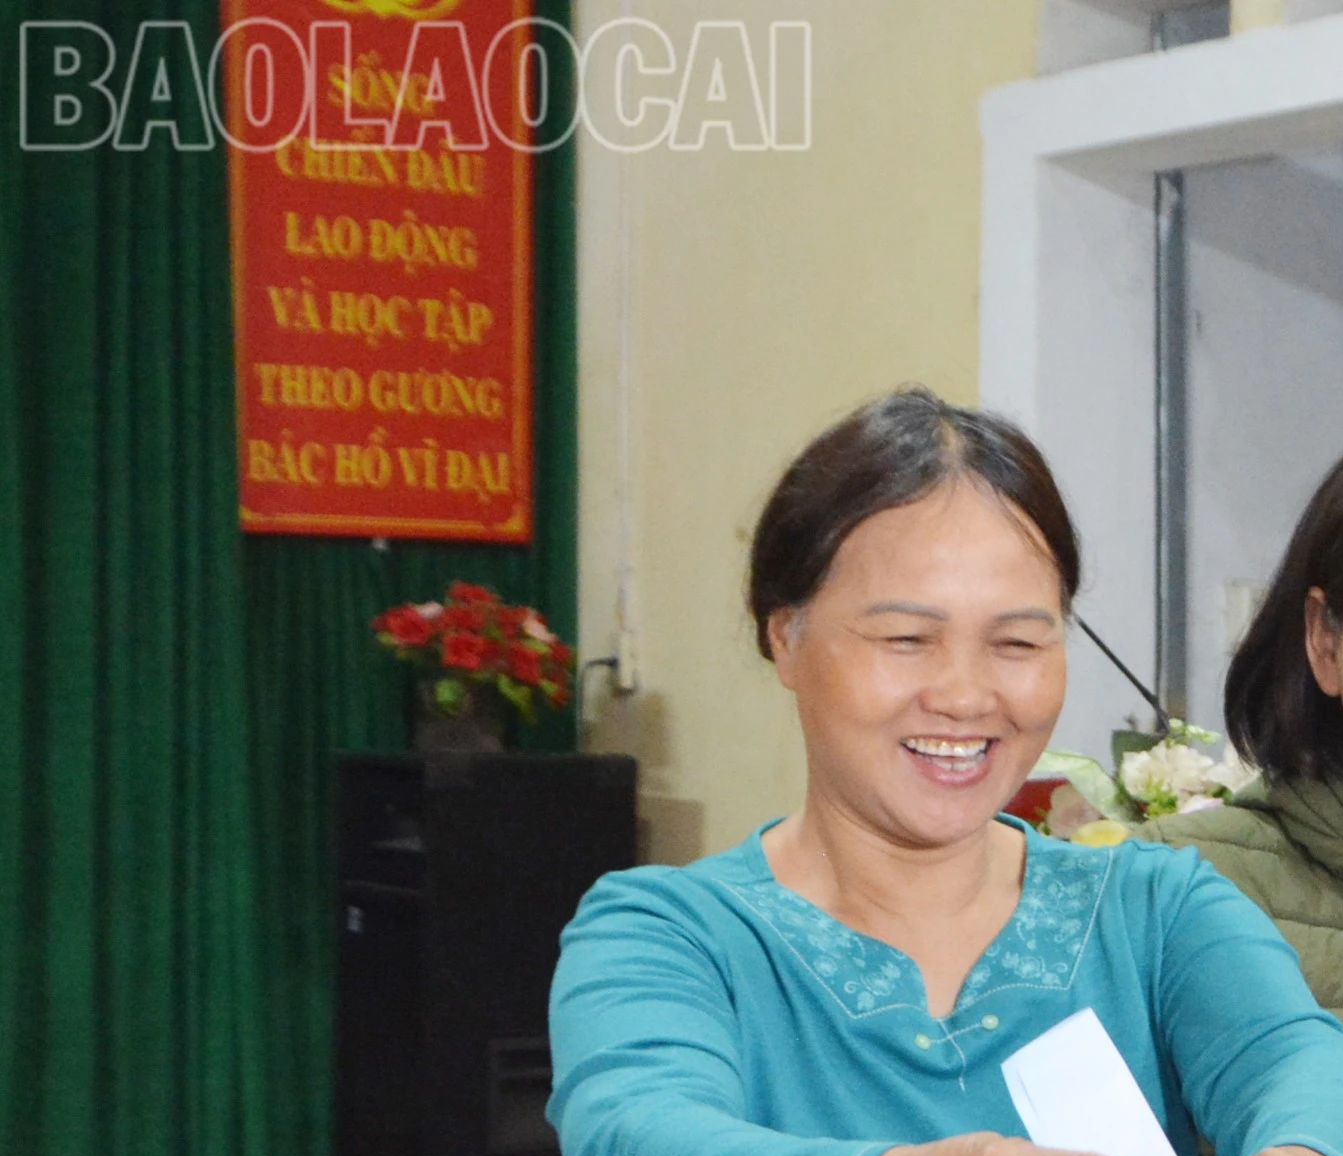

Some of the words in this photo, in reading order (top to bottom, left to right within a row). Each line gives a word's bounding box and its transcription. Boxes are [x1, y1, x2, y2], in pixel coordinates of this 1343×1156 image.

[328, 50, 435, 115] SỐNG
[285, 211, 364, 260] LAO
[368, 209, 479, 276] ĐỘNG
[266, 276, 323, 332] VÀ
[328, 291, 412, 347] HỌC
[417, 287, 494, 353] TẬP
[252, 363, 364, 411] THEO
[369, 366, 503, 418] GƯƠNG
[248, 427, 327, 486] BÁC
[332, 425, 393, 489] HỒ
[446, 449, 510, 506] ĐẠI
